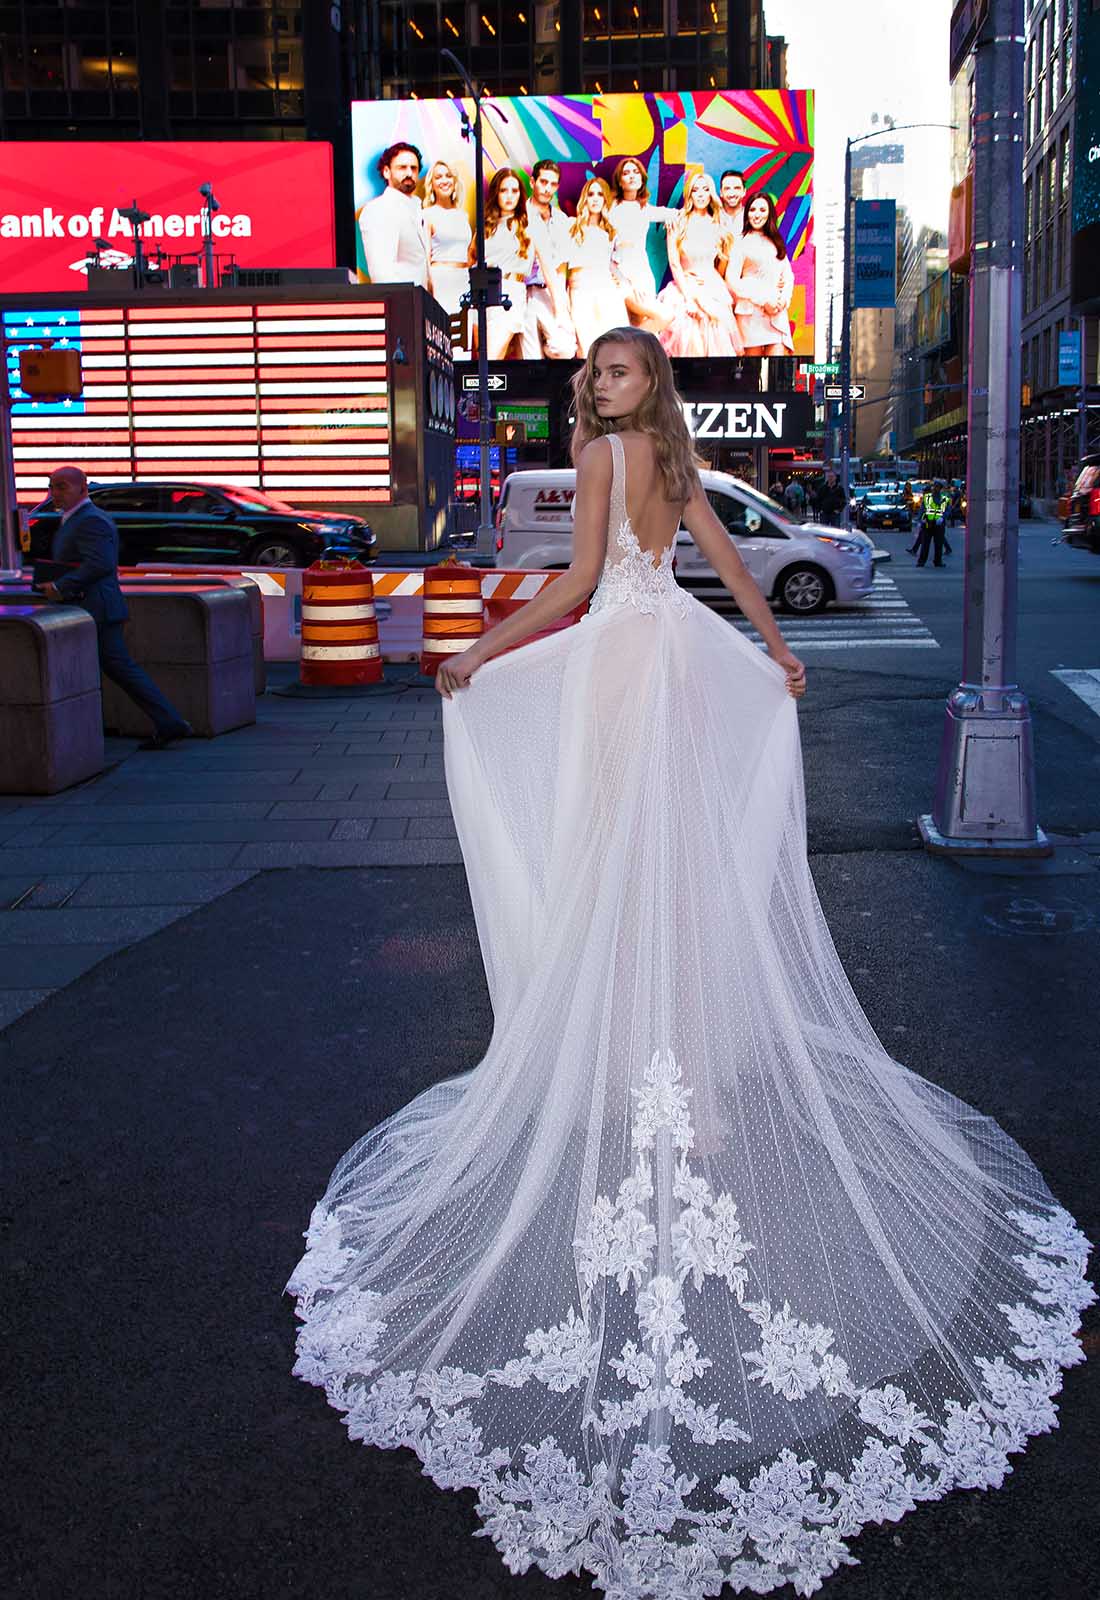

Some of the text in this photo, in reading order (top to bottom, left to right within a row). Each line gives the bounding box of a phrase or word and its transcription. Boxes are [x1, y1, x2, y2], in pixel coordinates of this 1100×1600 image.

[68, 208, 104, 238] of
[808, 363, 840, 374] Broadway
[681, 402, 787, 438] IZEN
